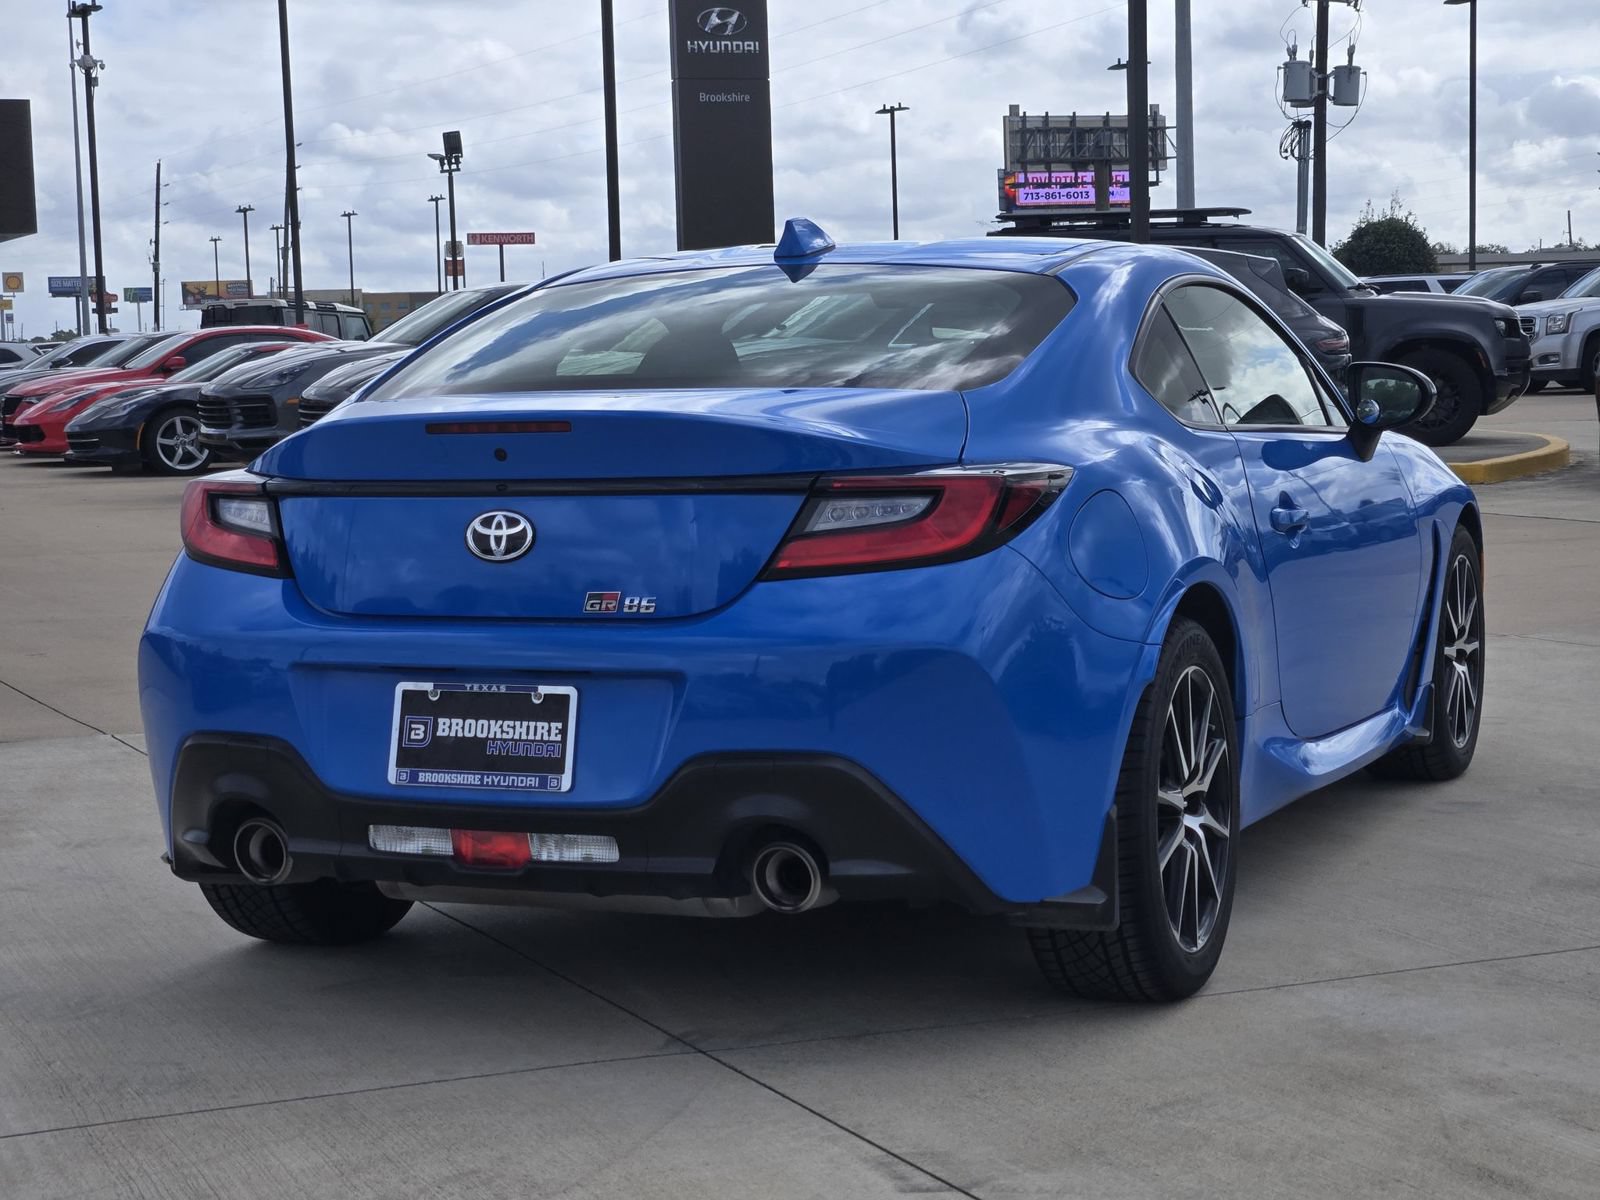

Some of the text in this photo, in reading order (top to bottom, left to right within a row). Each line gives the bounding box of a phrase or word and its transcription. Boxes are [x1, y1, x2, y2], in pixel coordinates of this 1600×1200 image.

[686, 40, 760, 53] HYUNDAI
[699, 92, 751, 102] Brookshire
[1023, 190, 1090, 201] 713-861-6013
[480, 234, 534, 243] KENWORTH
[585, 596, 657, 613] GR 86
[464, 683, 507, 692] TEXAS
[436, 717, 563, 741] BROOKSHIRE
[486, 740, 562, 758] HYUNDAI
[418, 772, 539, 787] BROOKSHIRE HYUNDAI
